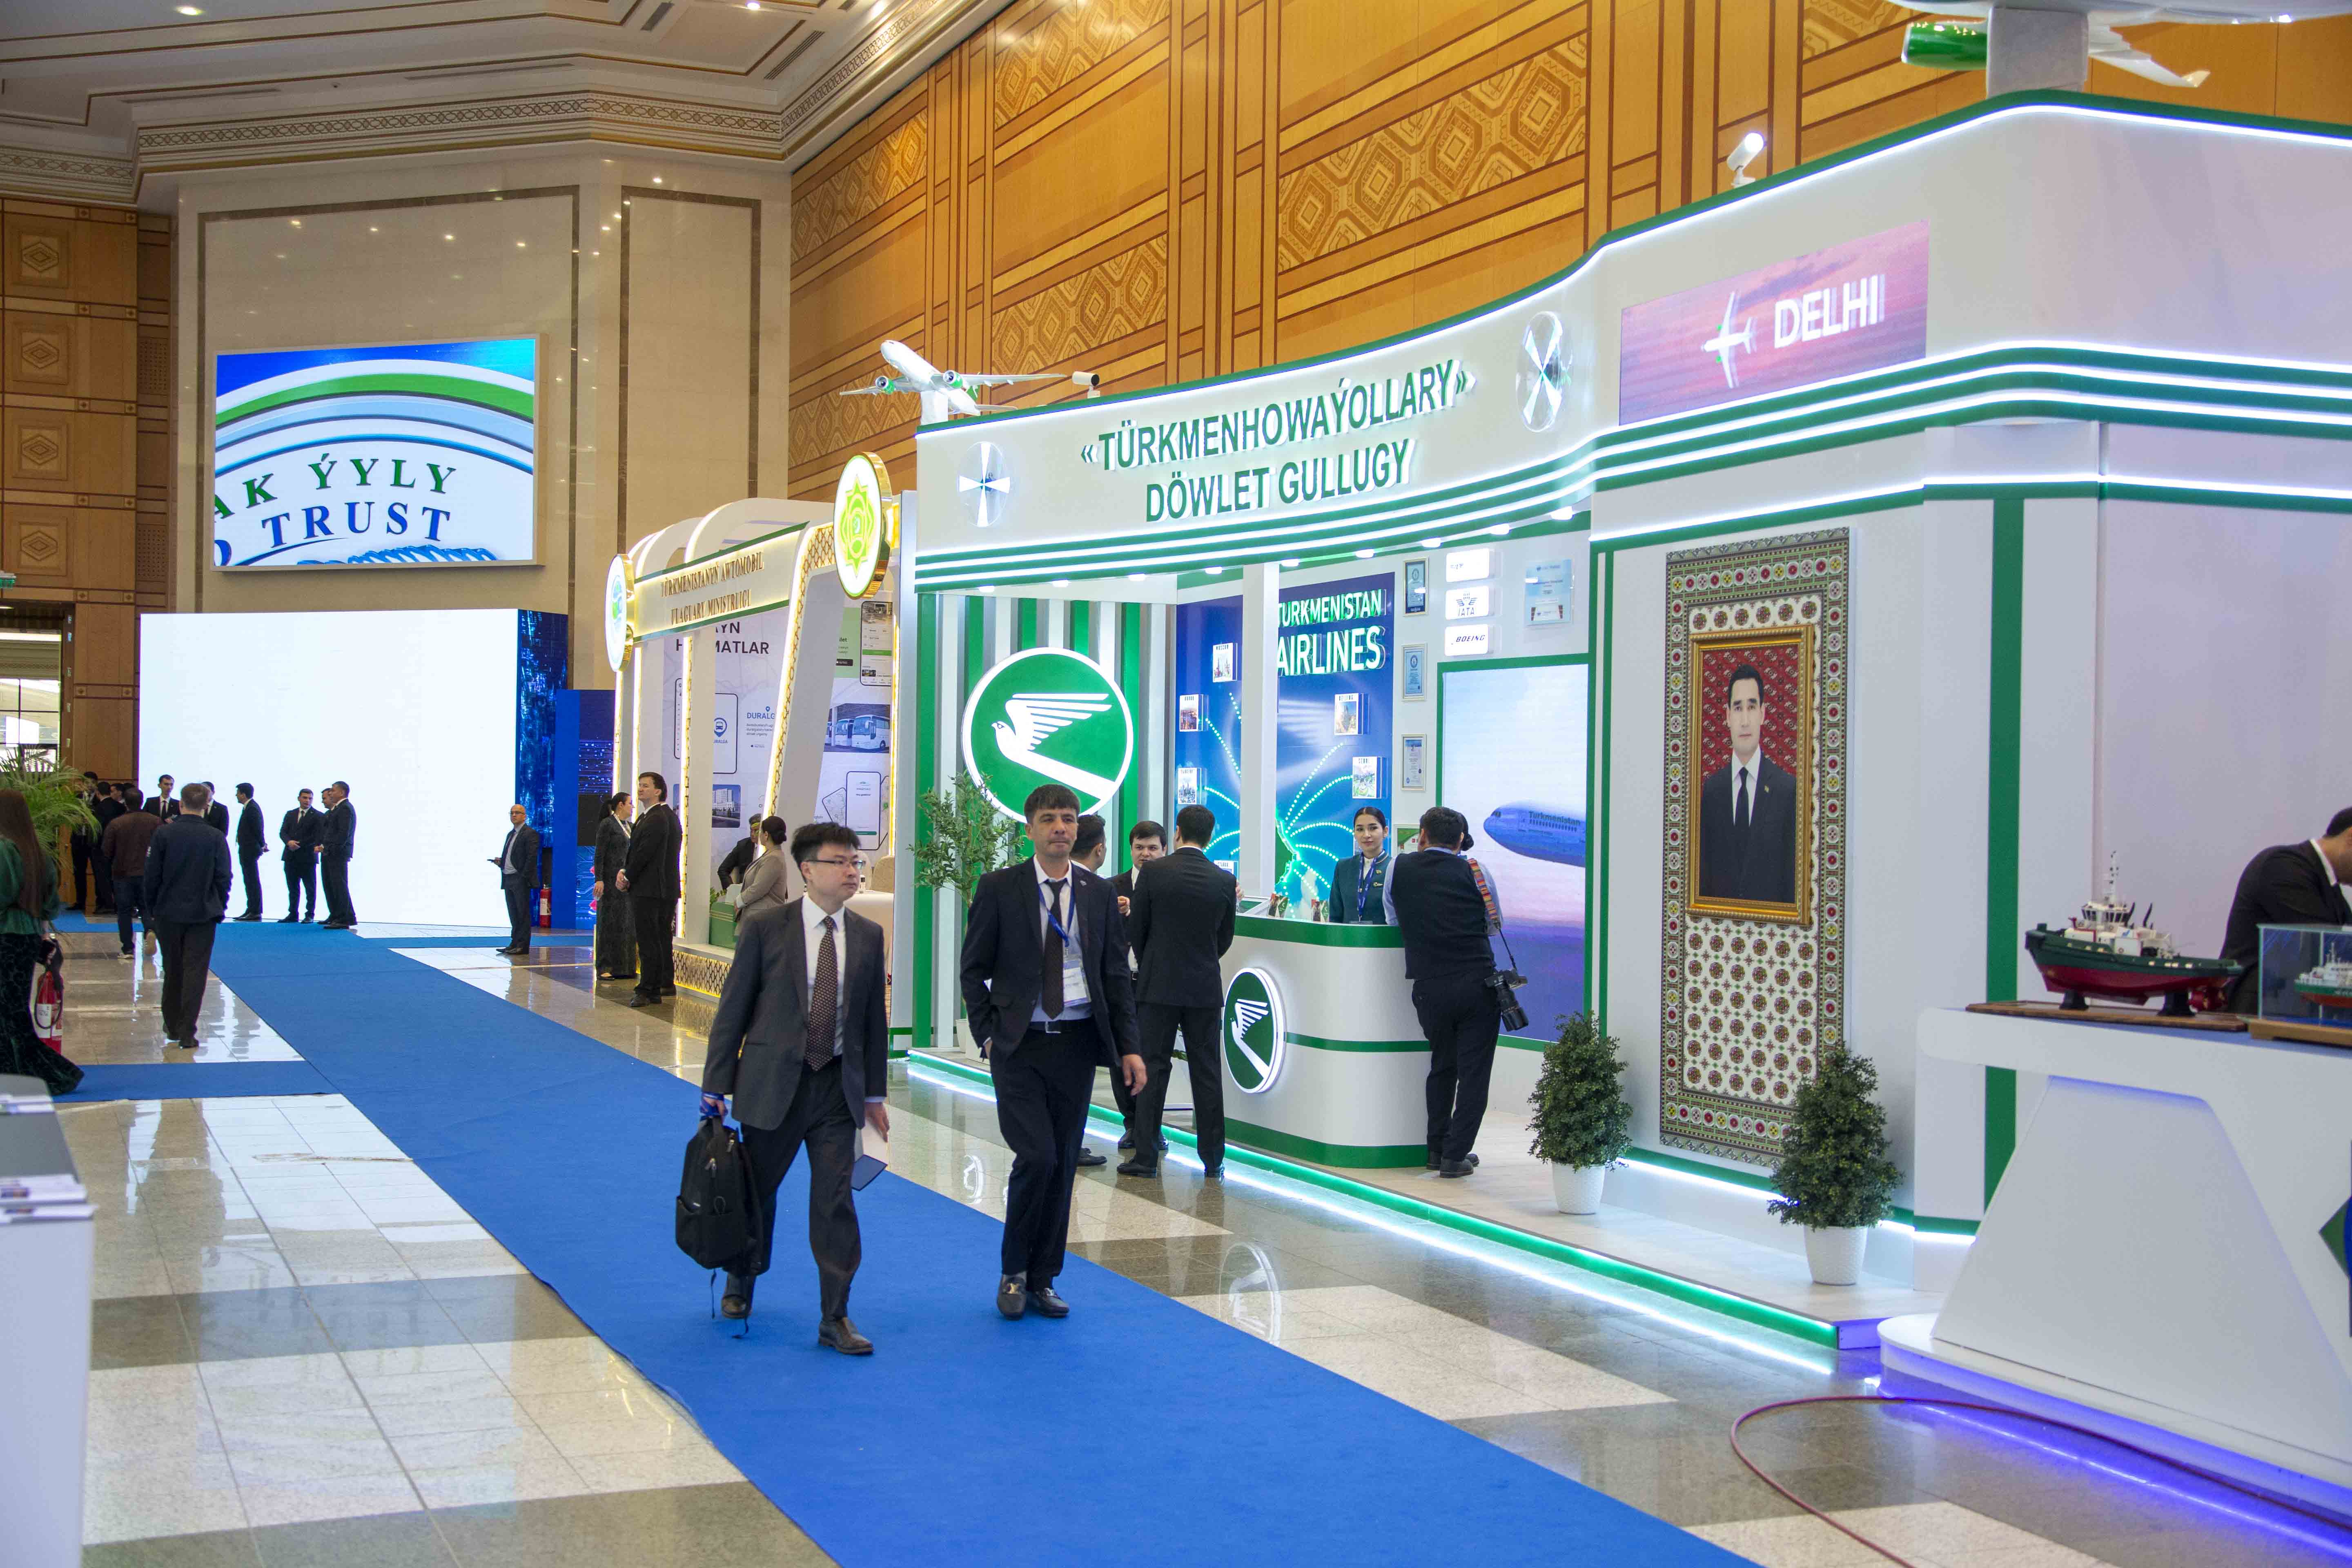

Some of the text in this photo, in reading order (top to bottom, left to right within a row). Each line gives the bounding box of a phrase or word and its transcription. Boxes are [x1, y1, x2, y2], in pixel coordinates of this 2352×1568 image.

[1774, 274, 1882, 348] DELHI
[308, 453, 457, 494] ÝYLY
[1146, 439, 1410, 522] DÖWLET GULLUGY
[261, 501, 450, 548] TRUST
[721, 552, 763, 581] AWTOMOBIL
[1278, 589, 1383, 628] TURKMENISTAN
[1458, 607, 1475, 617] IATA
[1277, 625, 1382, 676] AIRLINES
